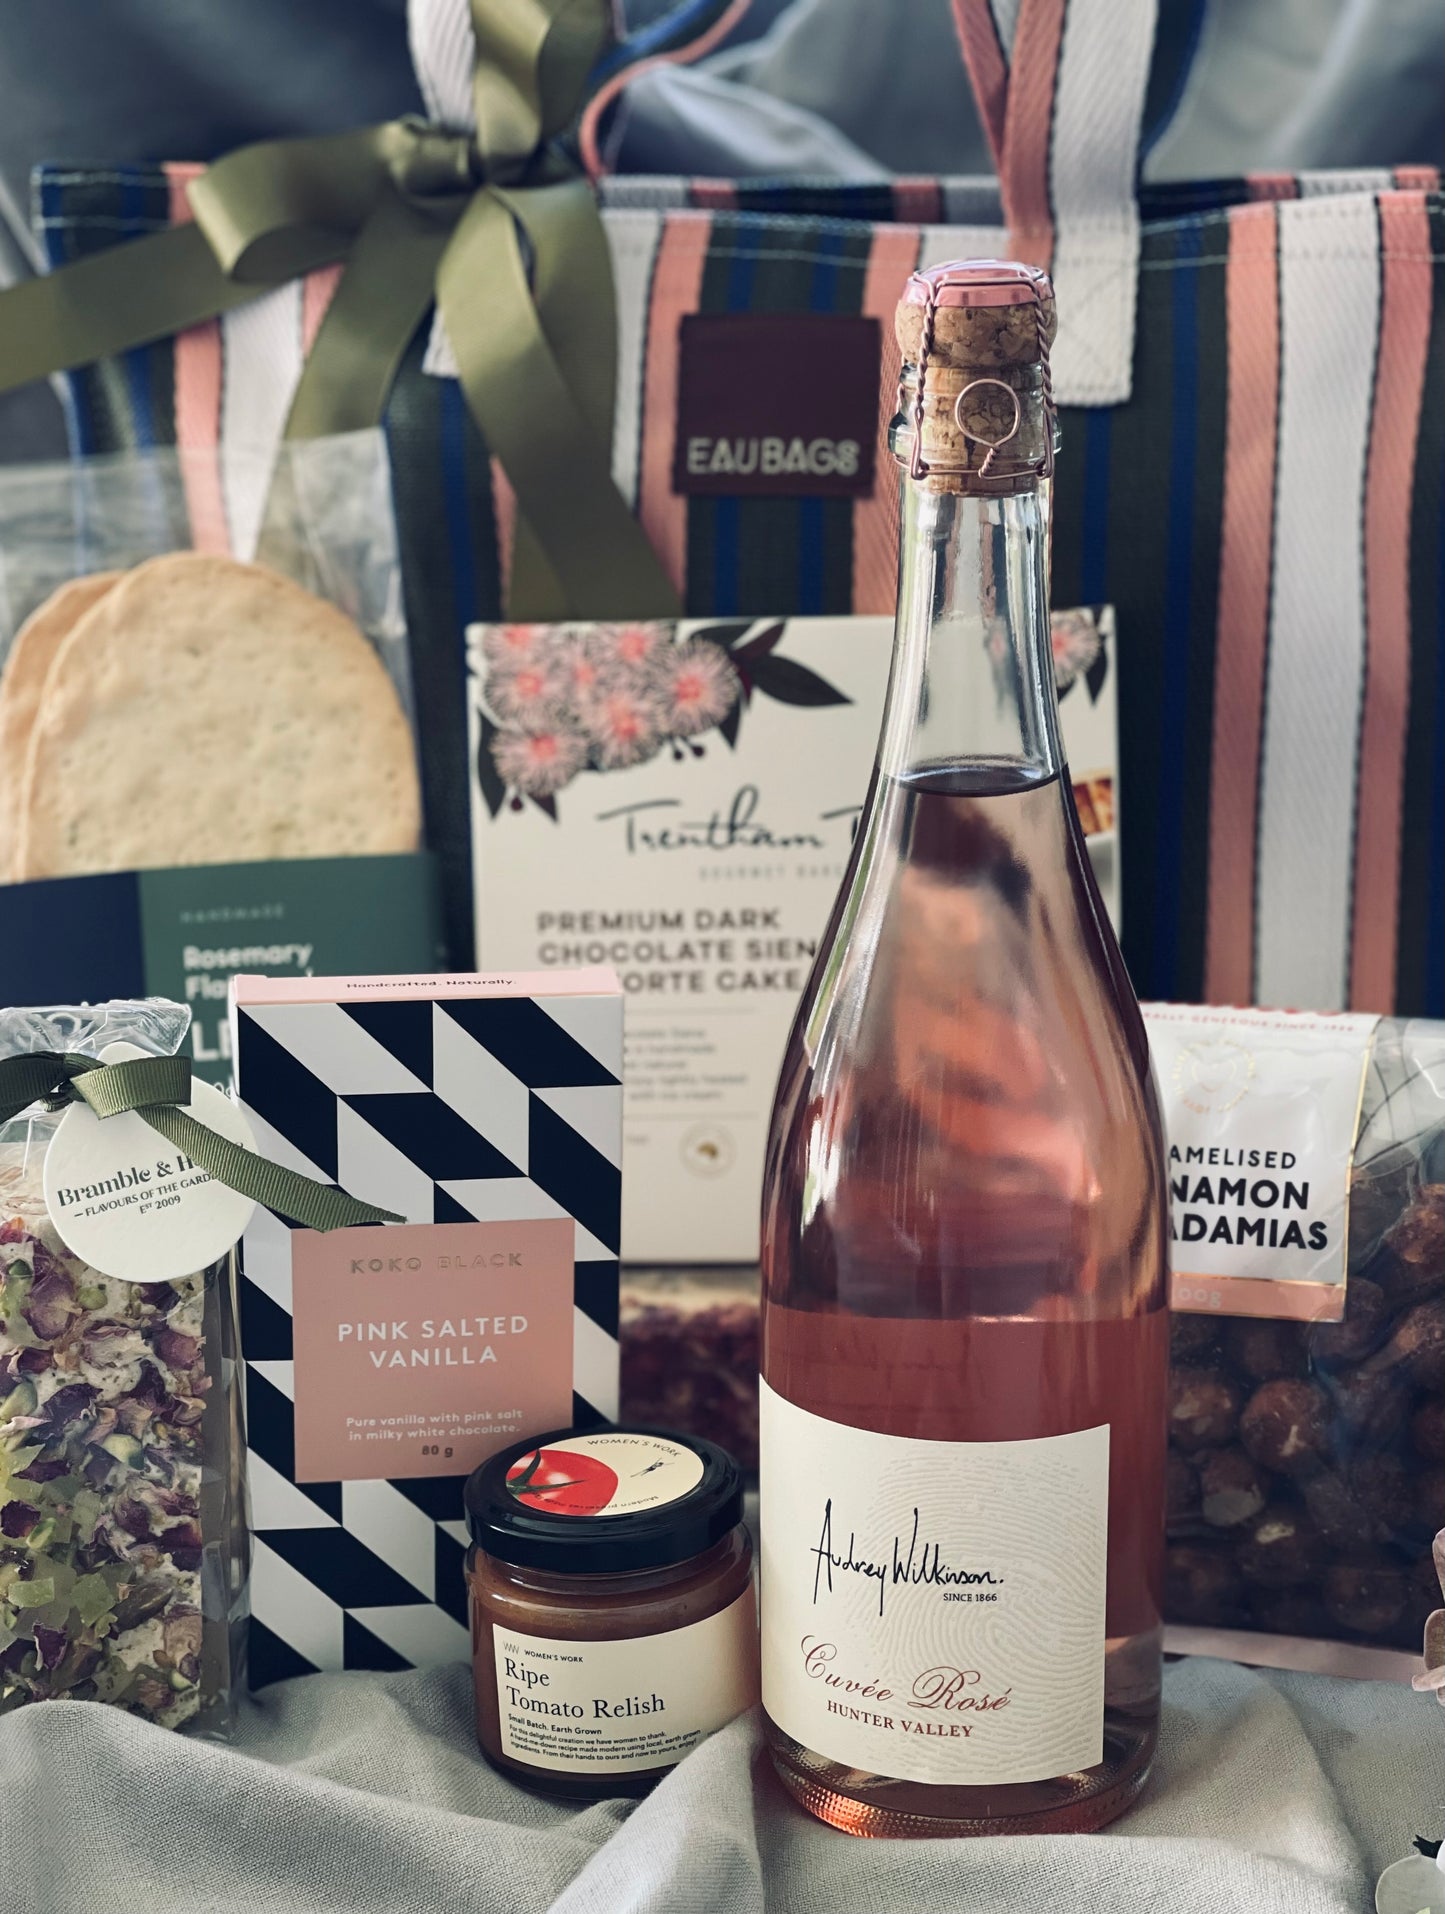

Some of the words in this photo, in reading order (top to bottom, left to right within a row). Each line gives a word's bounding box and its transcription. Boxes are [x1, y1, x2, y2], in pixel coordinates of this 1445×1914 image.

[687, 437, 860, 476] EAUBAGS
[595, 784, 825, 853] Trentham
[537, 909, 683, 934] PREMIUM
[694, 907, 781, 931] DARK
[183, 943, 313, 969] Rosemary
[537, 940, 735, 965] CHOCOLATE
[744, 938, 816, 961] SIEN
[185, 973, 234, 1001] Fla
[346, 980, 442, 989] Handcrafted.
[446, 978, 517, 987] Naturally.
[622, 970, 711, 995] ORTE
[717, 968, 801, 992] CAKE
[1169, 1144, 1297, 1170] AMELISED
[57, 1166, 152, 1207] Bramble
[156, 1160, 174, 1179] &
[140, 1189, 155, 1201] OF
[158, 1182, 180, 1197] THE
[180, 1172, 218, 1190] GARD
[1171, 1174, 1310, 1211] NAMON
[155, 1195, 182, 1211] 2009
[1171, 1213, 1329, 1252] DAMIAS
[351, 1257, 422, 1274] KOKO
[437, 1252, 523, 1269] BLACK
[338, 1321, 409, 1342] PINK
[421, 1315, 529, 1339] SALTED
[369, 1346, 498, 1369] VANILLA
[346, 1417, 376, 1428] Pure
[380, 1415, 426, 1426] vanilla
[430, 1412, 460, 1424] with
[464, 1410, 493, 1425] pink
[497, 1409, 524, 1420] salt
[349, 1430, 362, 1441] in
[366, 1428, 404, 1443] milky
[407, 1426, 446, 1439] white
[449, 1424, 521, 1437] chocolate.
[421, 1445, 439, 1457] 80
[444, 1446, 454, 1459] g
[587, 1438, 650, 1446] WOMEN'S
[652, 1443, 682, 1458] WORK
[810, 1497, 887, 1617] Audrey
[943, 1592, 972, 1602] SINCE
[975, 1592, 998, 1602] 1866
[524, 1648, 559, 1661] WOMEN'S
[560, 1655, 584, 1663] WORK
[504, 1657, 550, 1689] Ripe
[800, 1634, 894, 1702] Cuvée
[906, 1665, 1014, 1712] Rosé
[506, 1685, 584, 1719] Tomato
[592, 1694, 666, 1719] Relish
[508, 1713, 526, 1725] Small
[551, 1724, 573, 1735] Earth
[574, 1727, 602, 1735] Grown
[827, 1699, 895, 1730] HUNTER
[900, 1719, 975, 1738] VALLEY
[509, 1723, 518, 1732] For
[518, 1727, 528, 1736] this
[529, 1729, 558, 1742] delightful
[558, 1737, 584, 1745] creation
[596, 1737, 612, 1745] have
[613, 1736, 638, 1744] women
[514, 1733, 557, 1750] hand-me-down
[558, 1744, 578, 1753] recipe
[579, 1744, 598, 1753] made
[599, 1744, 626, 1753] modern
[627, 1743, 645, 1754] using
[646, 1740, 664, 1748] local,
[665, 1734, 682, 1744] earth
[682, 1729, 701, 1741] grown
[542, 1749, 559, 1758] From
[560, 1751, 574, 1759] their
[575, 1753, 595, 1761] hands
[596, 1753, 604, 1761] to
[621, 1751, 635, 1760] and
[635, 1750, 649, 1758] now
[650, 1748, 658, 1756] to
[658, 1745, 678, 1756] yours,
